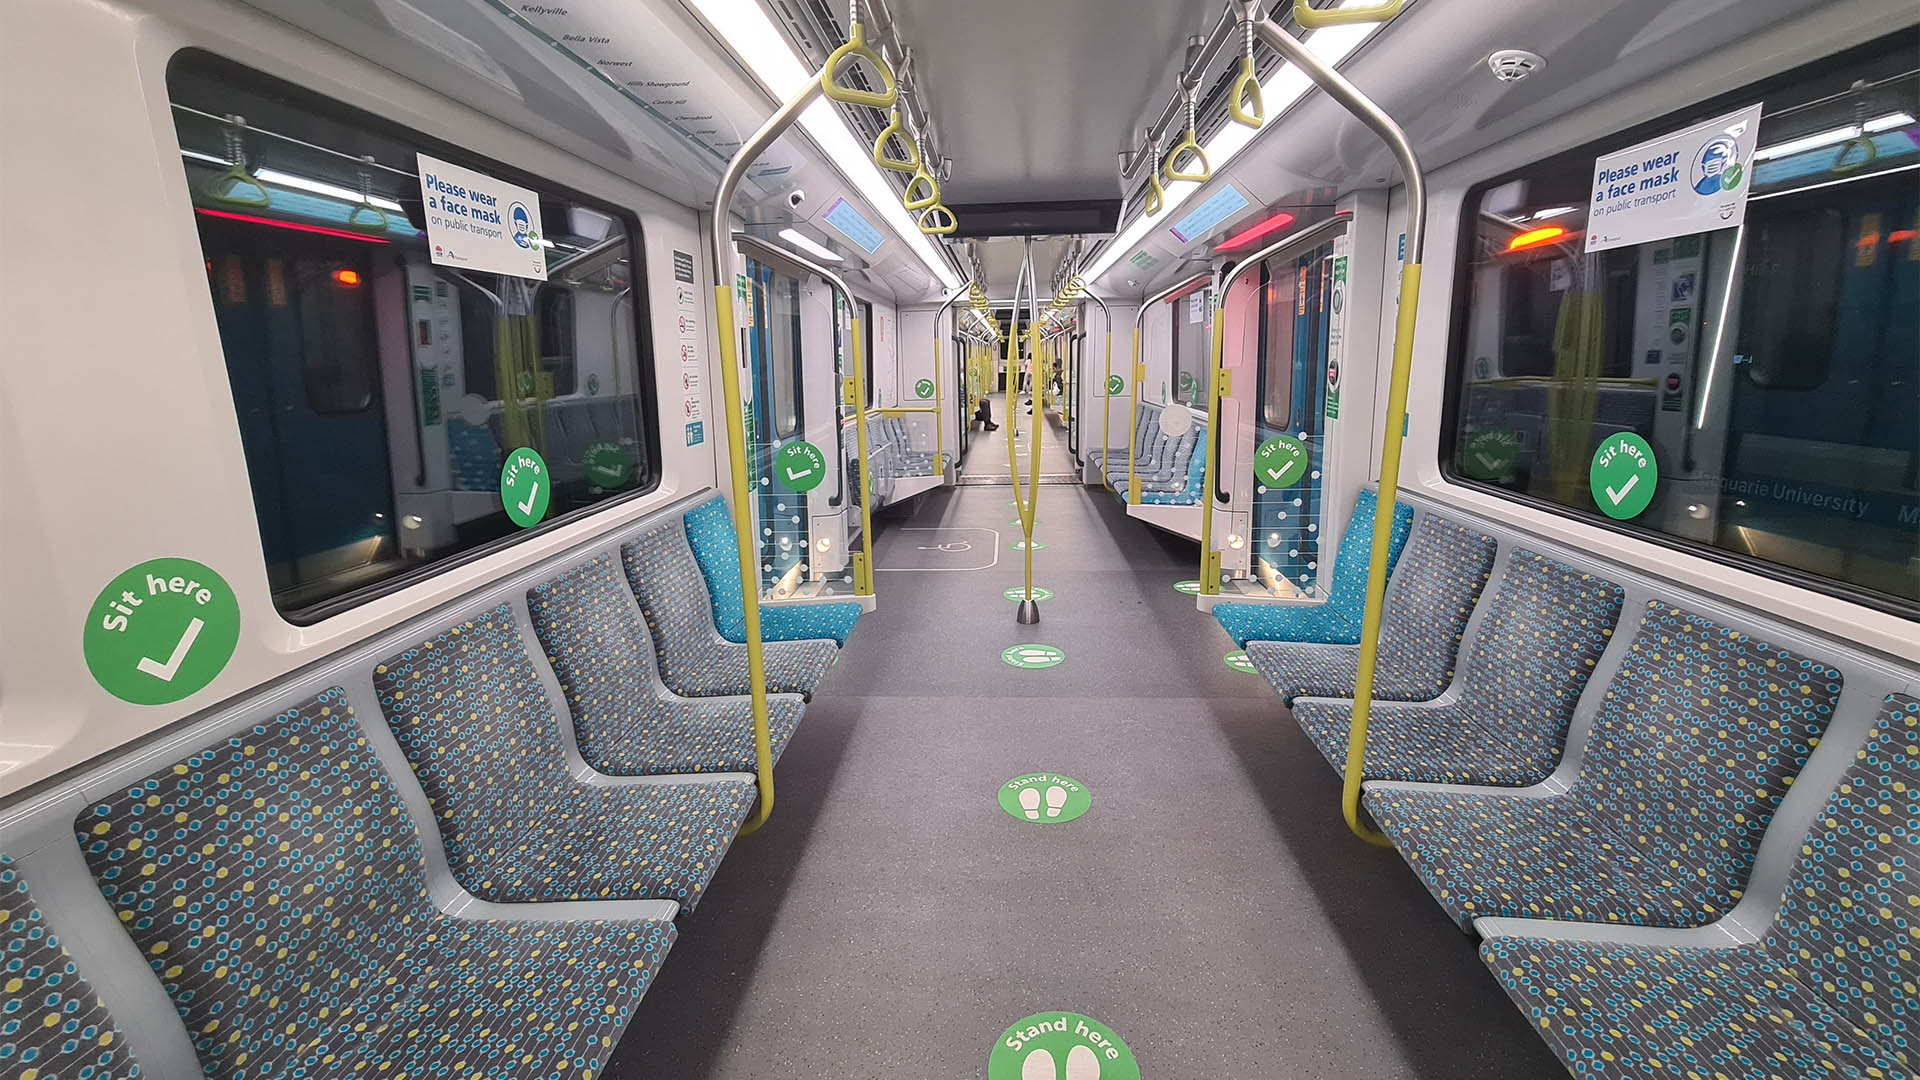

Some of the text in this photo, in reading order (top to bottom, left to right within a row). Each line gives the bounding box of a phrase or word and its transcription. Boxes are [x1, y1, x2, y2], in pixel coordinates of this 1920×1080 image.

[521, 4, 568, 16] Kellyville
[562, 34, 610, 44] Bella Vista
[597, 59, 633, 67] Norwest
[646, 80, 690, 88] Showground
[1598, 151, 1680, 186] Please wear
[425, 173, 497, 208] Please wear
[1595, 167, 1680, 202] a face mask
[429, 195, 502, 225] a face mask
[1593, 189, 1677, 217] on public transport
[431, 216, 503, 240] on public transport
[787, 446, 820, 469] Sit here
[1261, 440, 1300, 458] Sit here
[1599, 439, 1647, 469] Sit here
[506, 455, 541, 487] Sit here
[1772, 483, 1871, 518] University
[103, 574, 212, 632] Sit here
[1008, 775, 1079, 793] Stand here
[1006, 1017, 1120, 1060] Stand here
